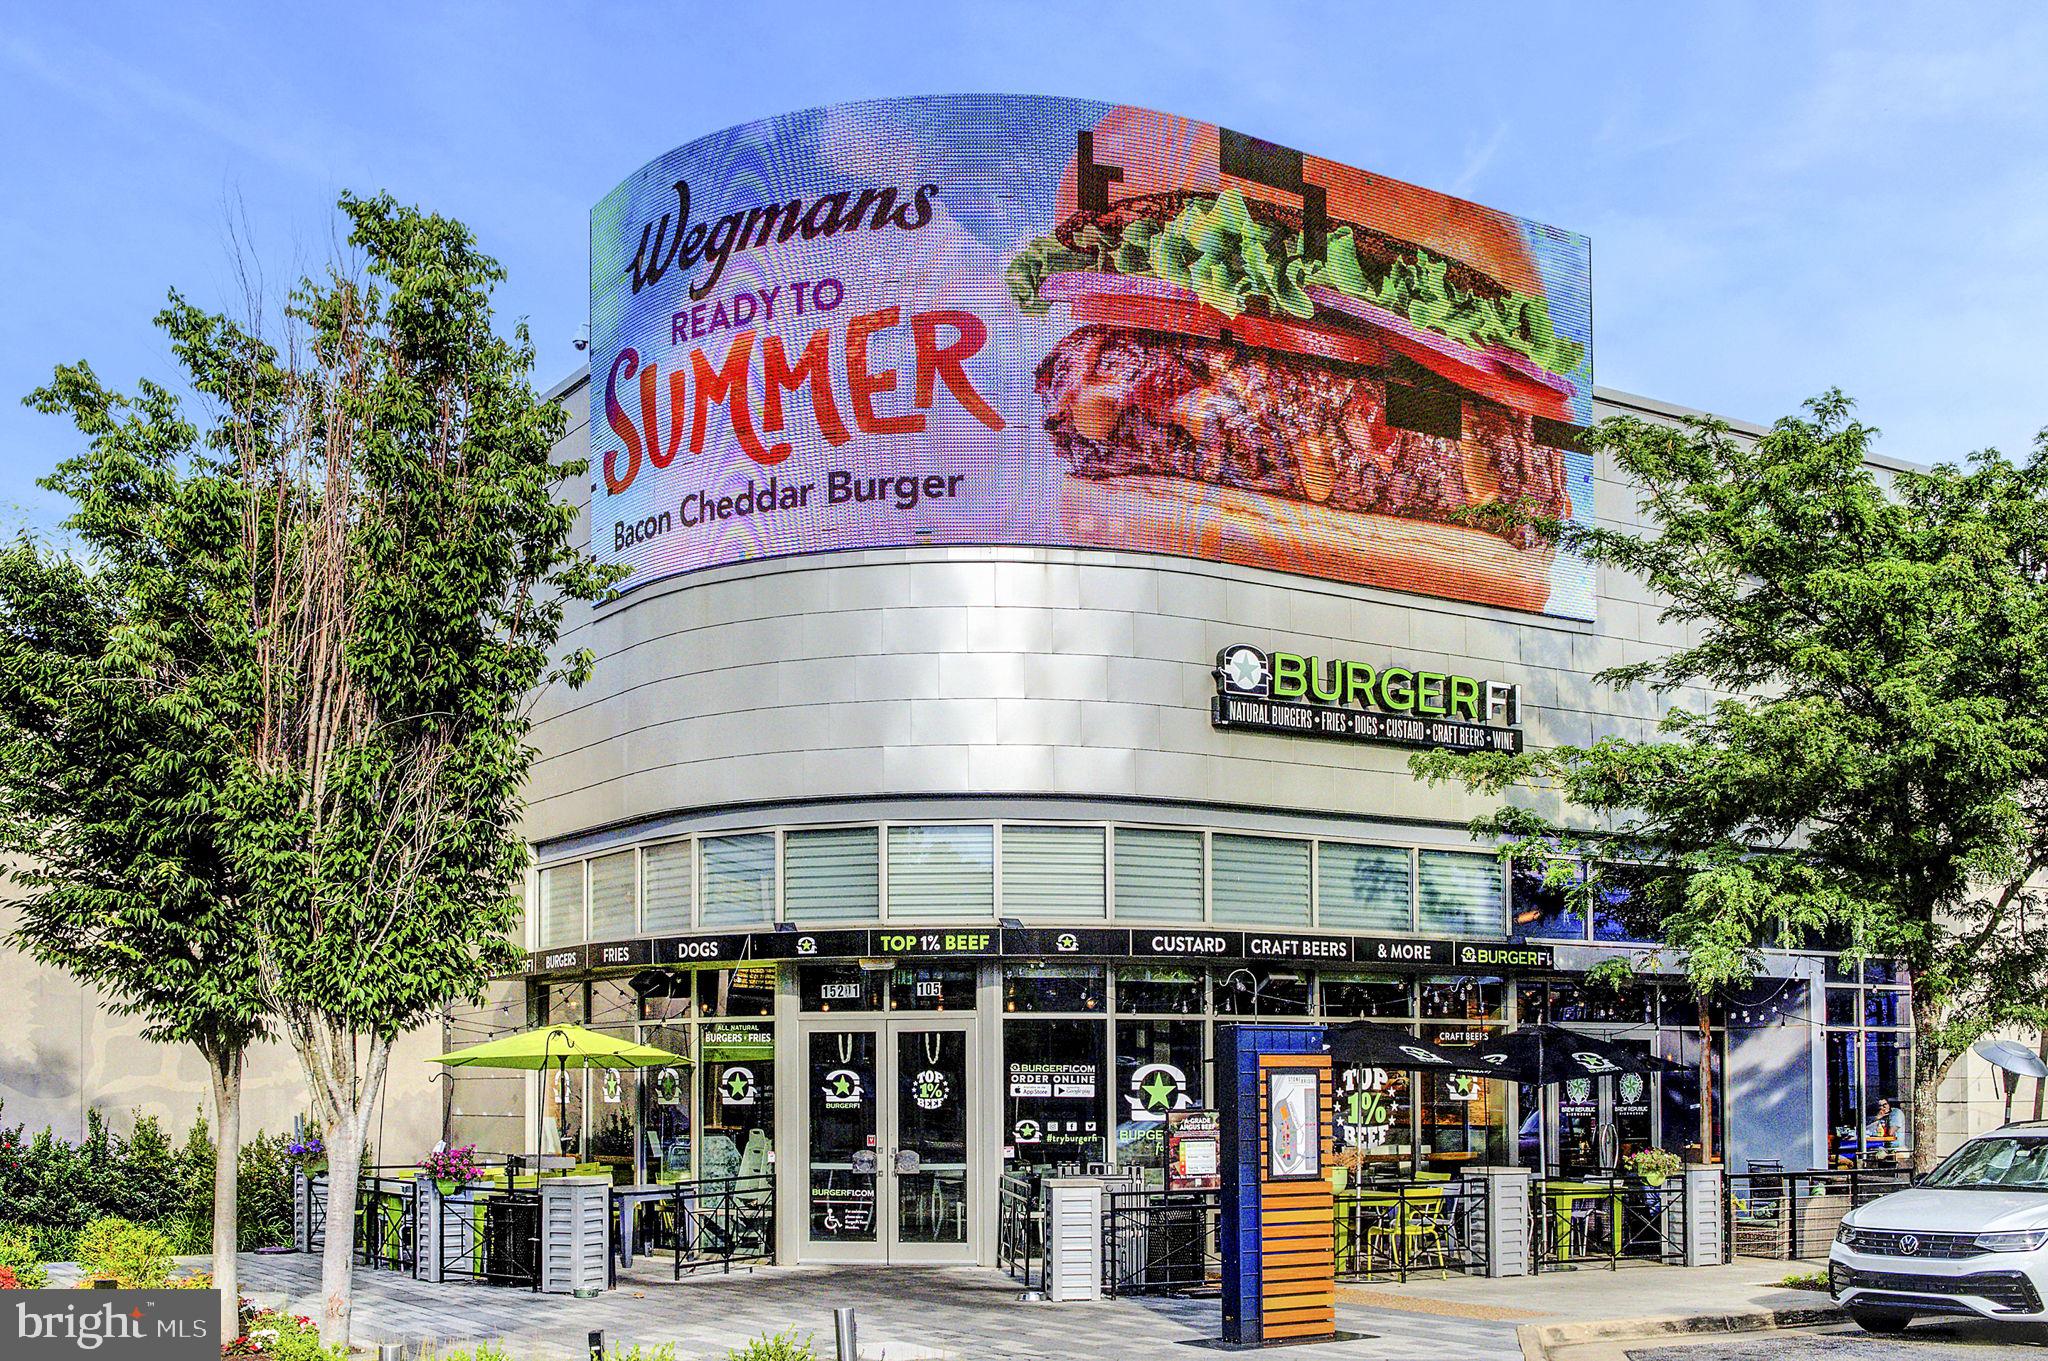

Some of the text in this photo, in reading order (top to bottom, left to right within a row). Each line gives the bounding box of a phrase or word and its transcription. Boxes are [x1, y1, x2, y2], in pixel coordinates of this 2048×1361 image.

[625, 180, 939, 301] Wegmans
[671, 277, 844, 345] READY TO
[602, 304, 1006, 497] SUMMER
[613, 471, 965, 552] Bacon Cheddar Burger
[1266, 652, 1522, 725] BURGERFI
[1229, 701, 1515, 751] NATURAL BURGERS FRIES DOGS CUSTARD CRAFT BEERS WINE
[678, 941, 718, 958] DOGS
[880, 934, 990, 952] TOP 1% BEEF
[1152, 936, 1226, 952] CUSTARD
[1251, 938, 1347, 957] CRAFT BEERS
[545, 951, 577, 970] BURGERS
[603, 946, 630, 963] FRIES
[1378, 944, 1432, 960] & MORE
[919, 983, 940, 996] 105
[705, 1033, 771, 1042] BURGERS FRIES
[1439, 1032, 1464, 1041] CRAFT
[916, 1070, 944, 1084] TOP
[1021, 1064, 1096, 1073] BURGERFI.COM
[1011, 1075, 1095, 1084] ORDER ONLINE
[1342, 1067, 1389, 1091] TOP
[919, 1083, 943, 1098] 1%
[916, 1097, 945, 1110] BEEF
[1347, 1092, 1387, 1125] 1%
[1119, 1130, 1164, 1142] BURGE
[1343, 1124, 1389, 1149] BEEF
[812, 1188, 875, 1197] BURGERFI.COM
